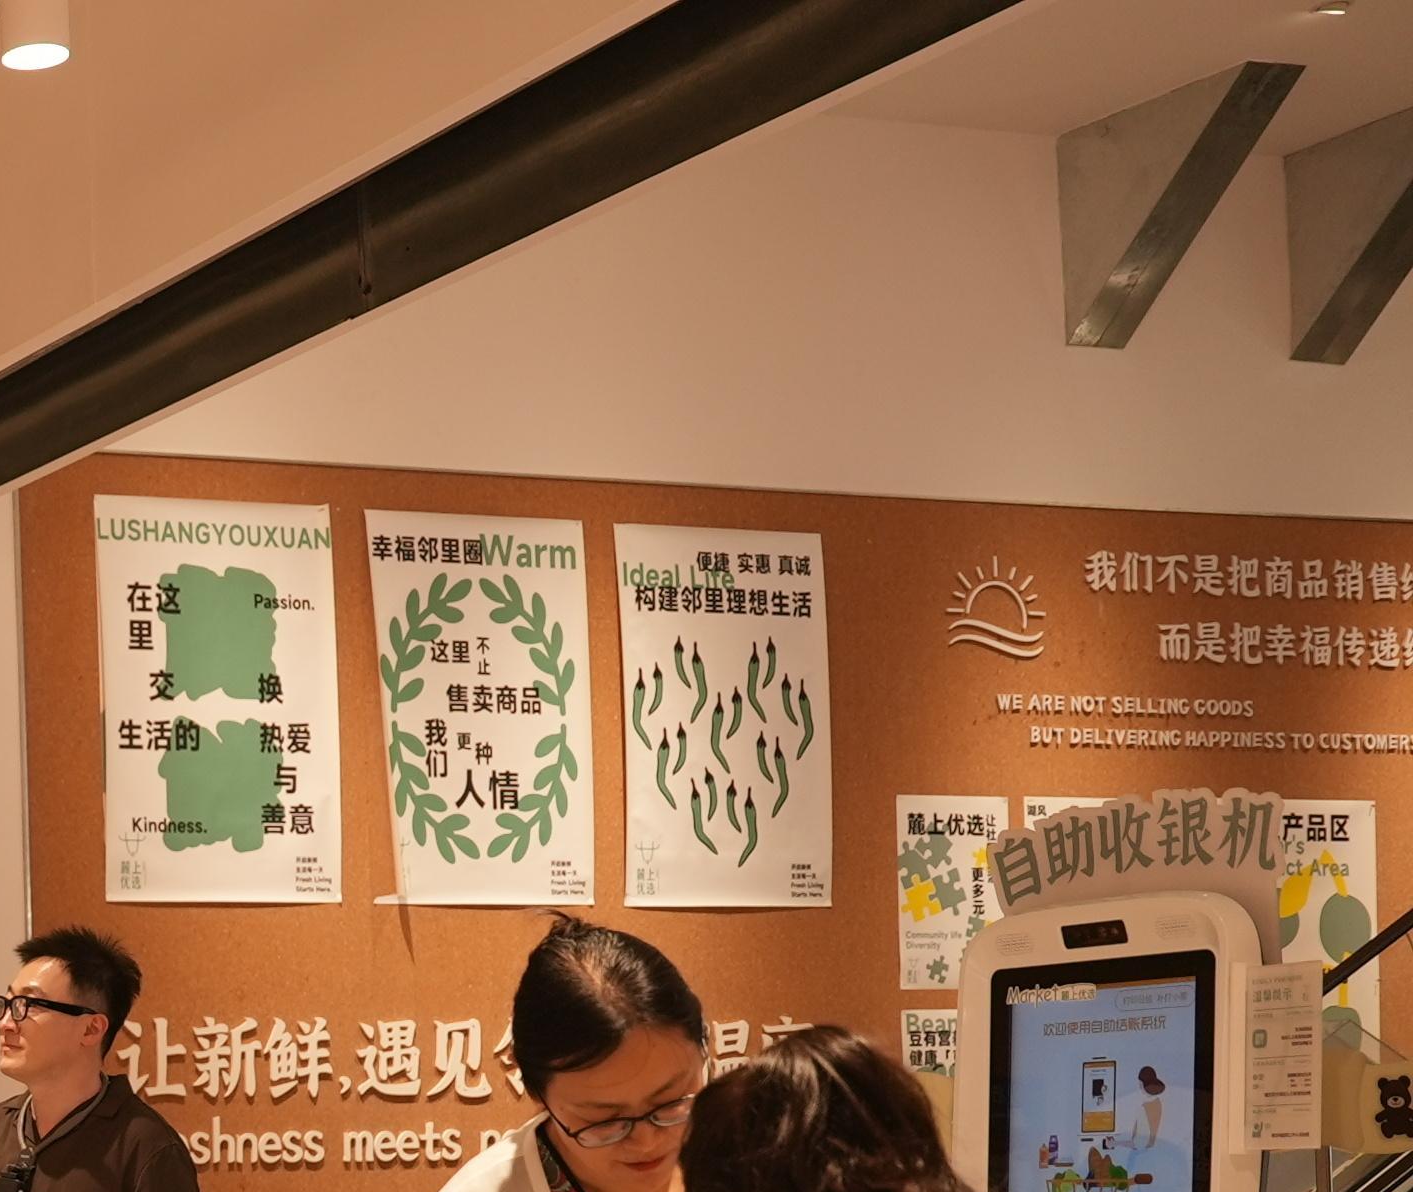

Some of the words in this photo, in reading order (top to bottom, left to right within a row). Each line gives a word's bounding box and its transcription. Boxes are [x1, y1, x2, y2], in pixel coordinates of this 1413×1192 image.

[96, 517, 331, 550] LUSHANGYOUXUAN
[372, 535, 483, 565] 幸福邻里圈
[479, 533, 576, 569] Warm
[696, 551, 729, 573] 便捷
[737, 553, 770, 574] 实惠
[778, 555, 811, 576] 真诚
[623, 562, 681, 588] Ideal
[690, 565, 735, 589] Life
[127, 582, 182, 614] 在这
[254, 593, 315, 611] Passion.
[635, 585, 812, 618] 构建邻里理想生活
[128, 620, 154, 650] 里
[431, 639, 471, 663] 这里
[476, 636, 491, 675] 不止
[149, 669, 174, 701] 交
[258, 673, 283, 704] 换
[446, 684, 542, 714] 售卖商品
[997, 694, 1023, 712] WE
[1027, 695, 1065, 713] ARE
[1070, 695, 1107, 714] NOT
[1111, 696, 1190, 716] SELLING
[1193, 699, 1254, 718] GOODS
[118, 719, 200, 752] 生活的
[259, 722, 311, 754] 热爱
[425, 718, 448, 778] 我们
[457, 732, 472, 750] 更
[1030, 726, 1065, 746] BUT
[1070, 727, 1181, 748] DELIVERING
[1185, 729, 1286, 750] HAPPINESS
[1289, 732, 1315, 750] TO
[475, 741, 493, 765] 种
[273, 763, 297, 794] 与
[456, 769, 519, 810] 人情
[132, 816, 208, 834] Kindness.
[261, 803, 315, 835] 善意
[907, 813, 985, 836] 麓上优选
[994, 796, 1276, 907] 自助收银机
[1309, 859, 1351, 877] Area
[905, 930, 949, 942] Community
[905, 940, 941, 951] Diversity
[1005, 984, 1058, 1008] Market
[180, 1115, 325, 1166] shness
[343, 1121, 463, 1165] meets
